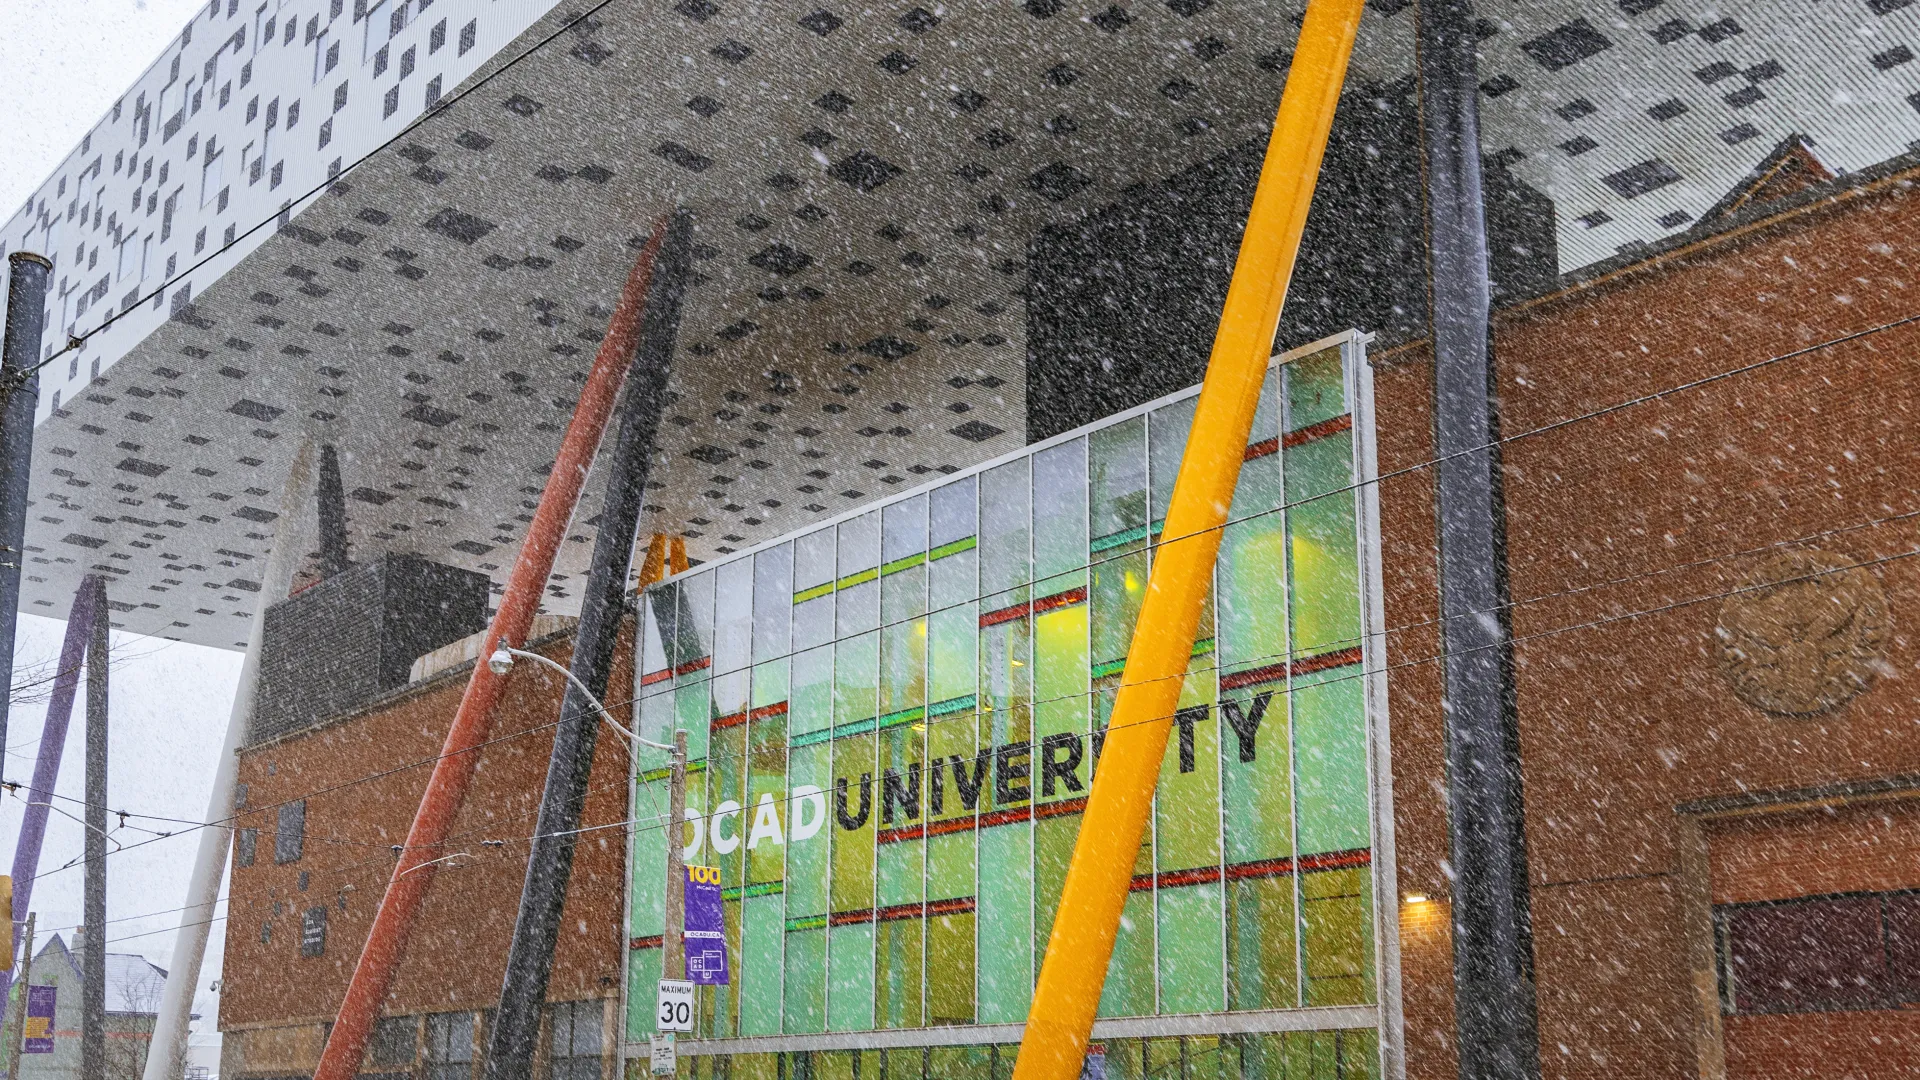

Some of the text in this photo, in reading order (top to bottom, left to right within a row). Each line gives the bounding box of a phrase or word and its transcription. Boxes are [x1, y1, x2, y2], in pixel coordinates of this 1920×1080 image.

[837, 690, 1274, 831] UNIVERTY
[687, 866, 721, 886] 100
[661, 985, 692, 995] MAXIMUM
[660, 1001, 690, 1024] 30
